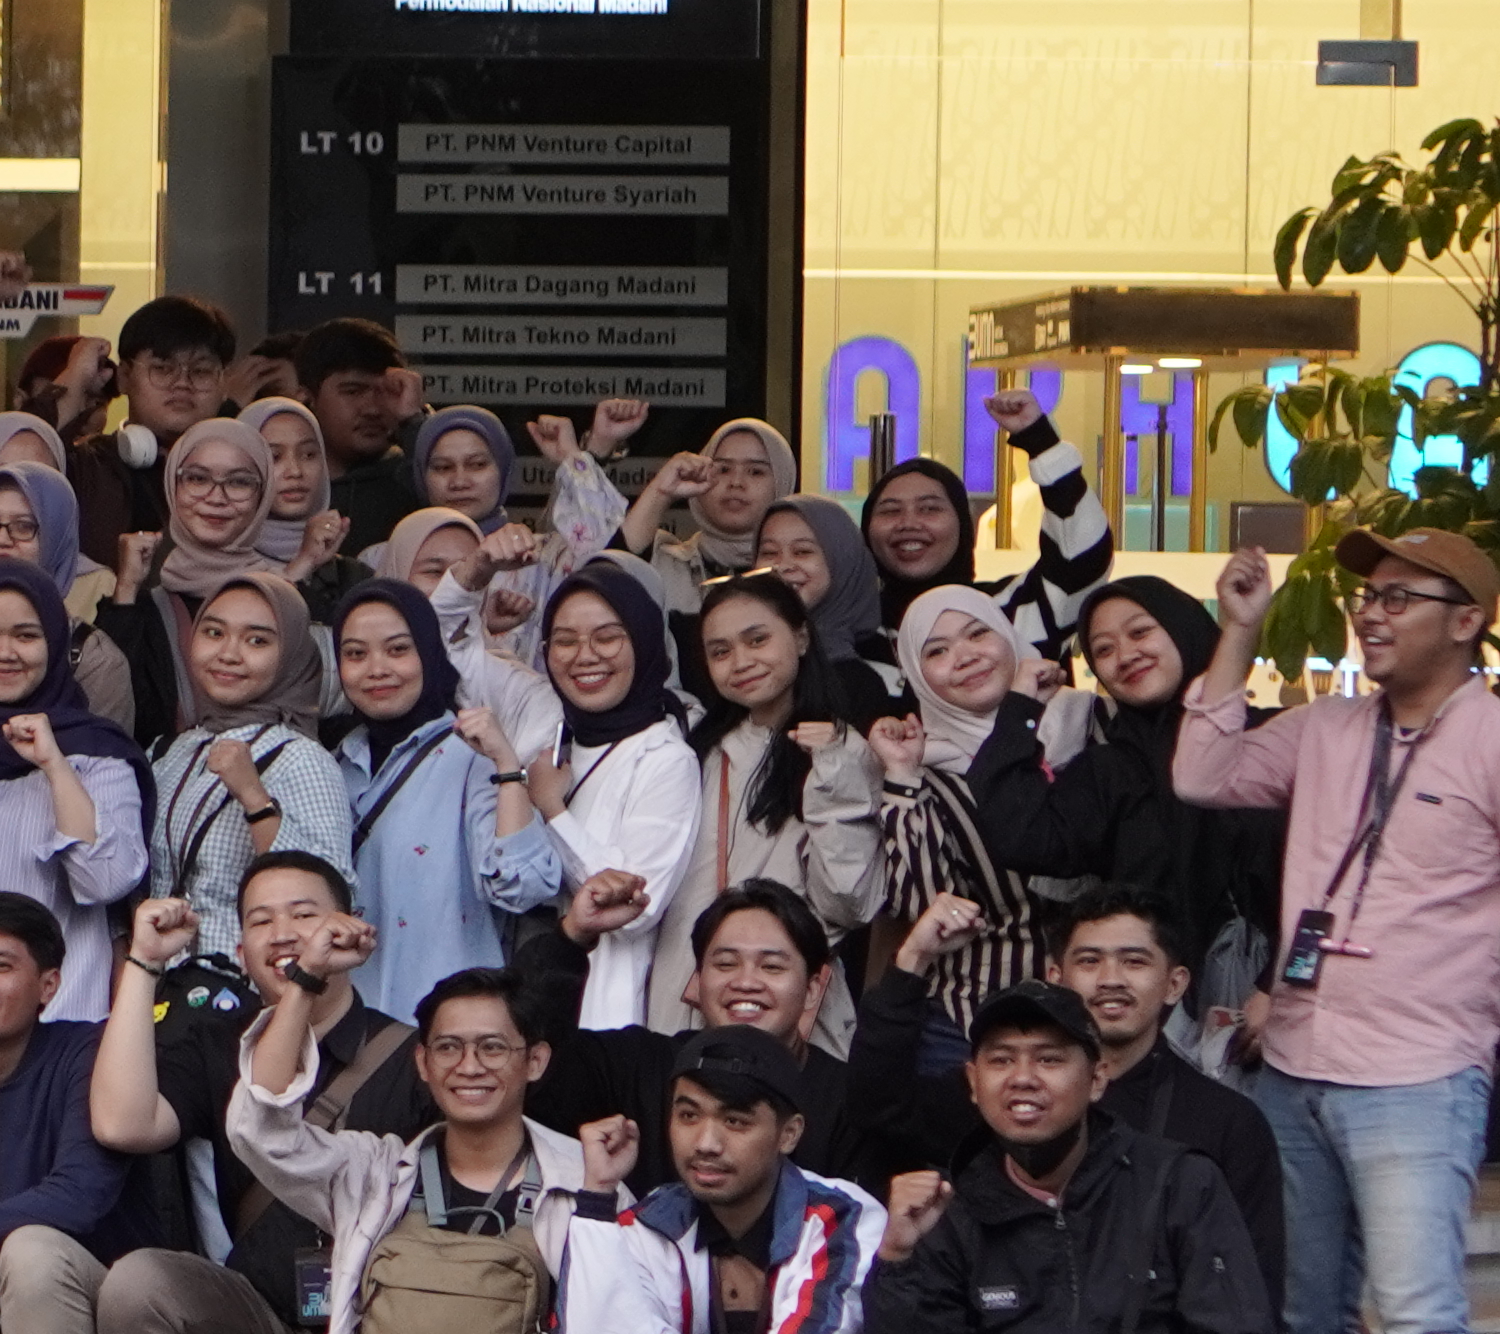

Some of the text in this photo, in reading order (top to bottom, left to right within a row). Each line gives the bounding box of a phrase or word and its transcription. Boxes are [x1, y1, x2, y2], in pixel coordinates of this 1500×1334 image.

[299, 131, 692, 157] LT 10 PT. PNM Venture Capital
[424, 184, 697, 207] PT. PNM Venture Syariah
[298, 271, 697, 298] LT 11 PT. Mitra Dagang Madani
[423, 324, 677, 346] PT. Mitra Tekno Madani
[422, 374, 705, 397] PT. Mitra Proteksi Madani
[522, 467, 555, 484] Uta
